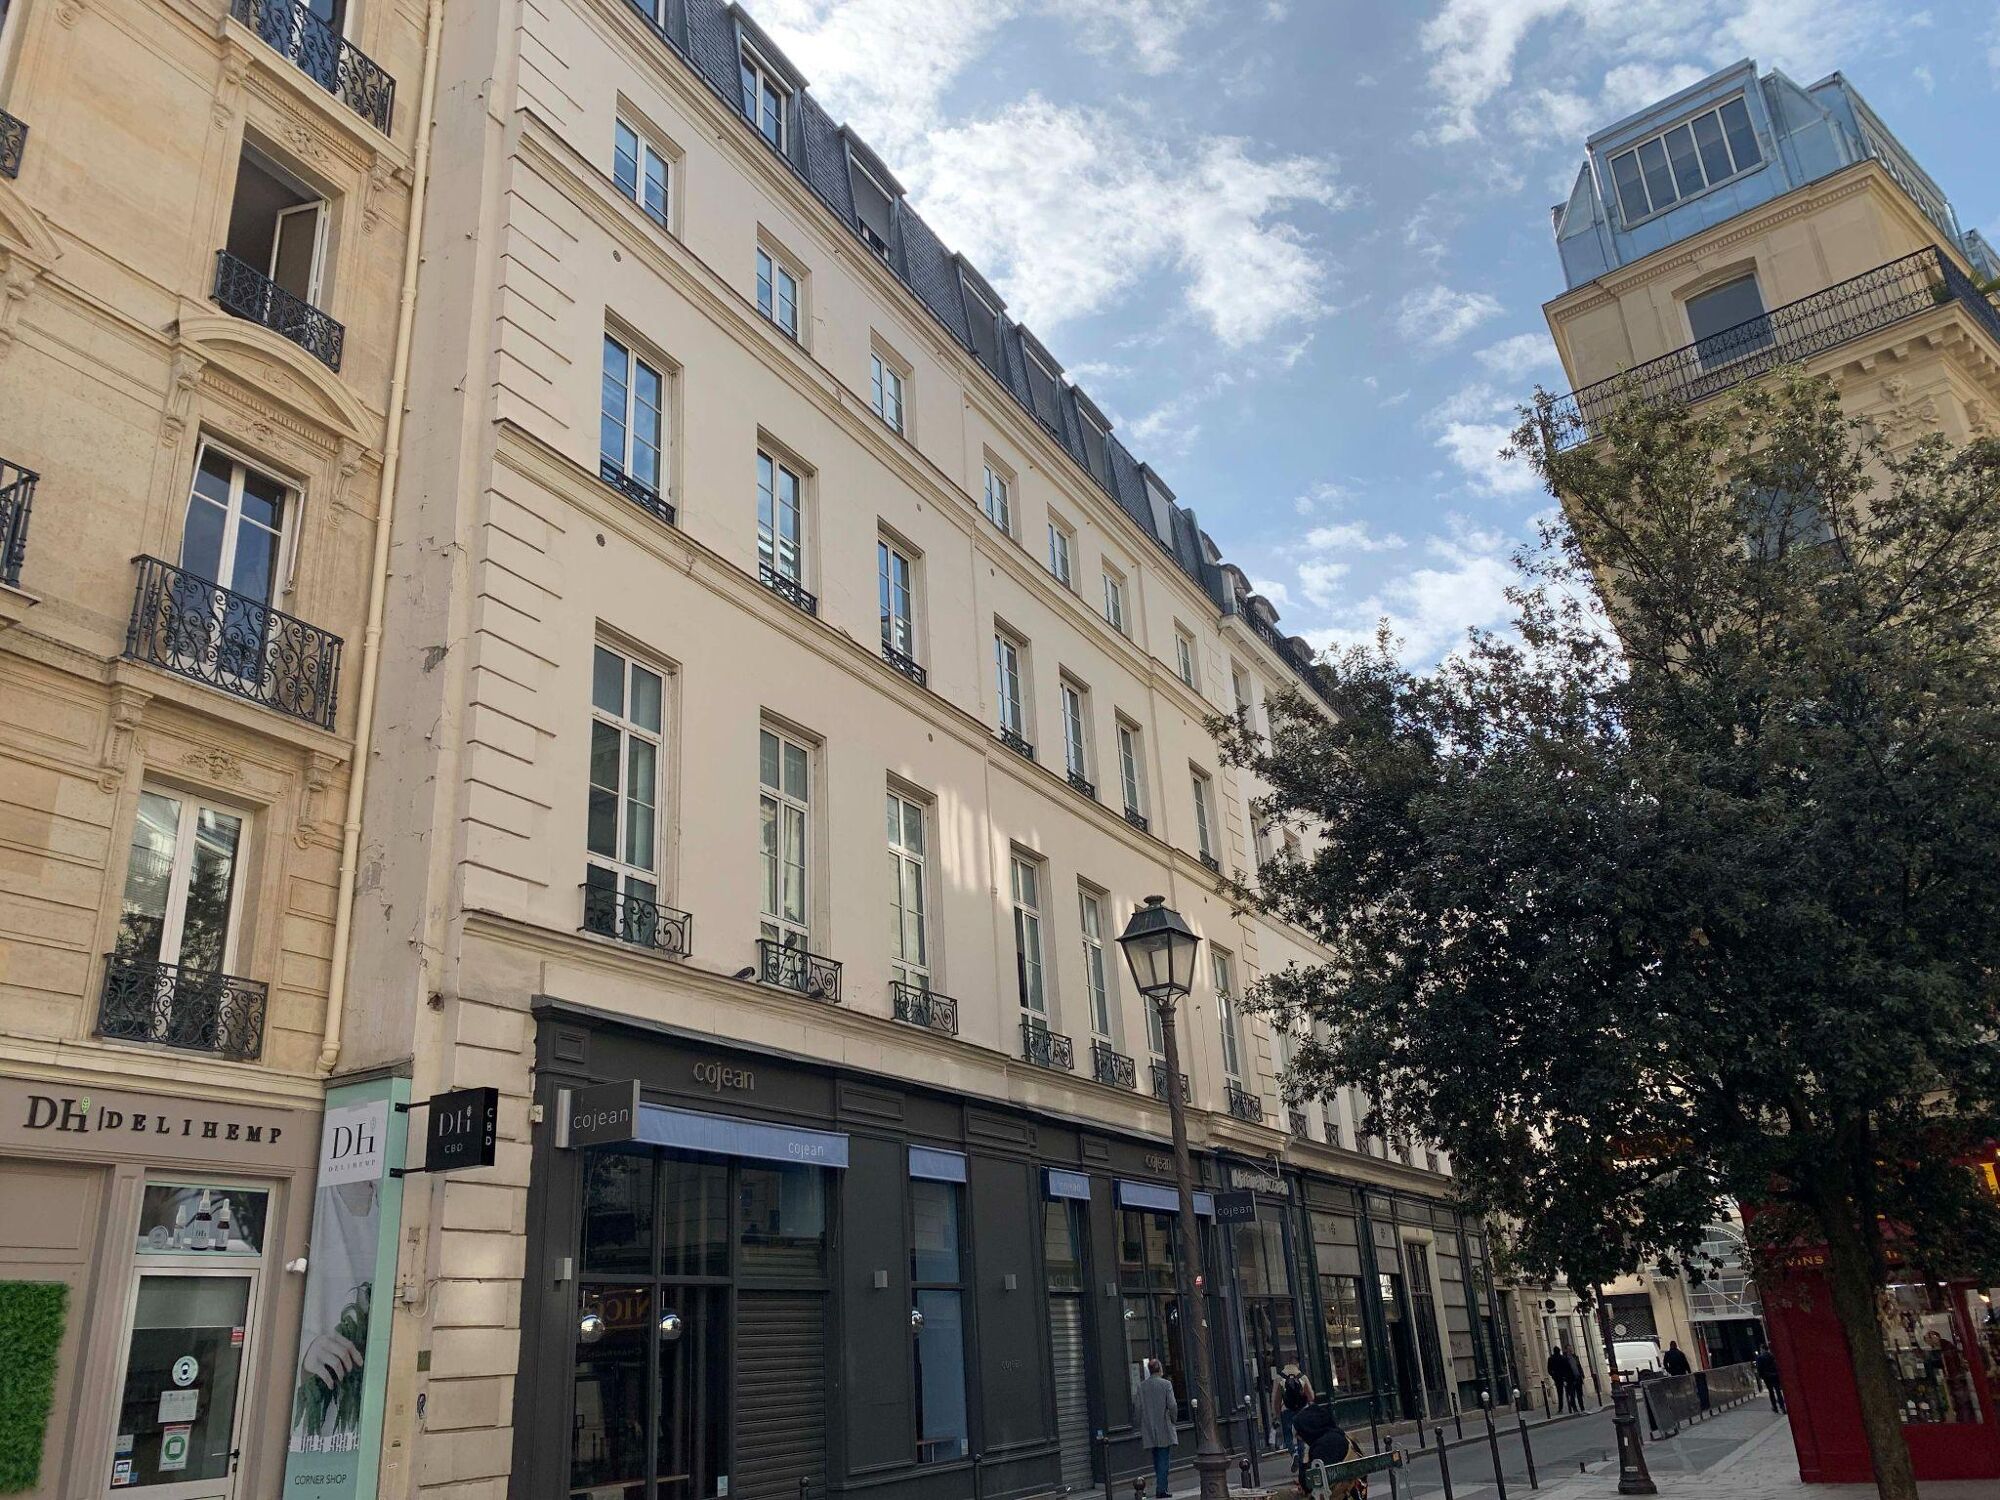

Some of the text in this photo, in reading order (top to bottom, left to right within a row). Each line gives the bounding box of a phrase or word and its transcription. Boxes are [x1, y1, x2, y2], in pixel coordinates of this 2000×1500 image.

[692, 1062, 755, 1092] cojean
[105, 1110, 282, 1144] DELIHEMP
[573, 1107, 629, 1132] cojean
[444, 1143, 463, 1154] CBD
[788, 1142, 824, 1158] cojean
[1145, 1152, 1172, 1173] cojean
[1217, 1204, 1252, 1216] cojean
[295, 1474, 347, 1485] CORNER SHOP
